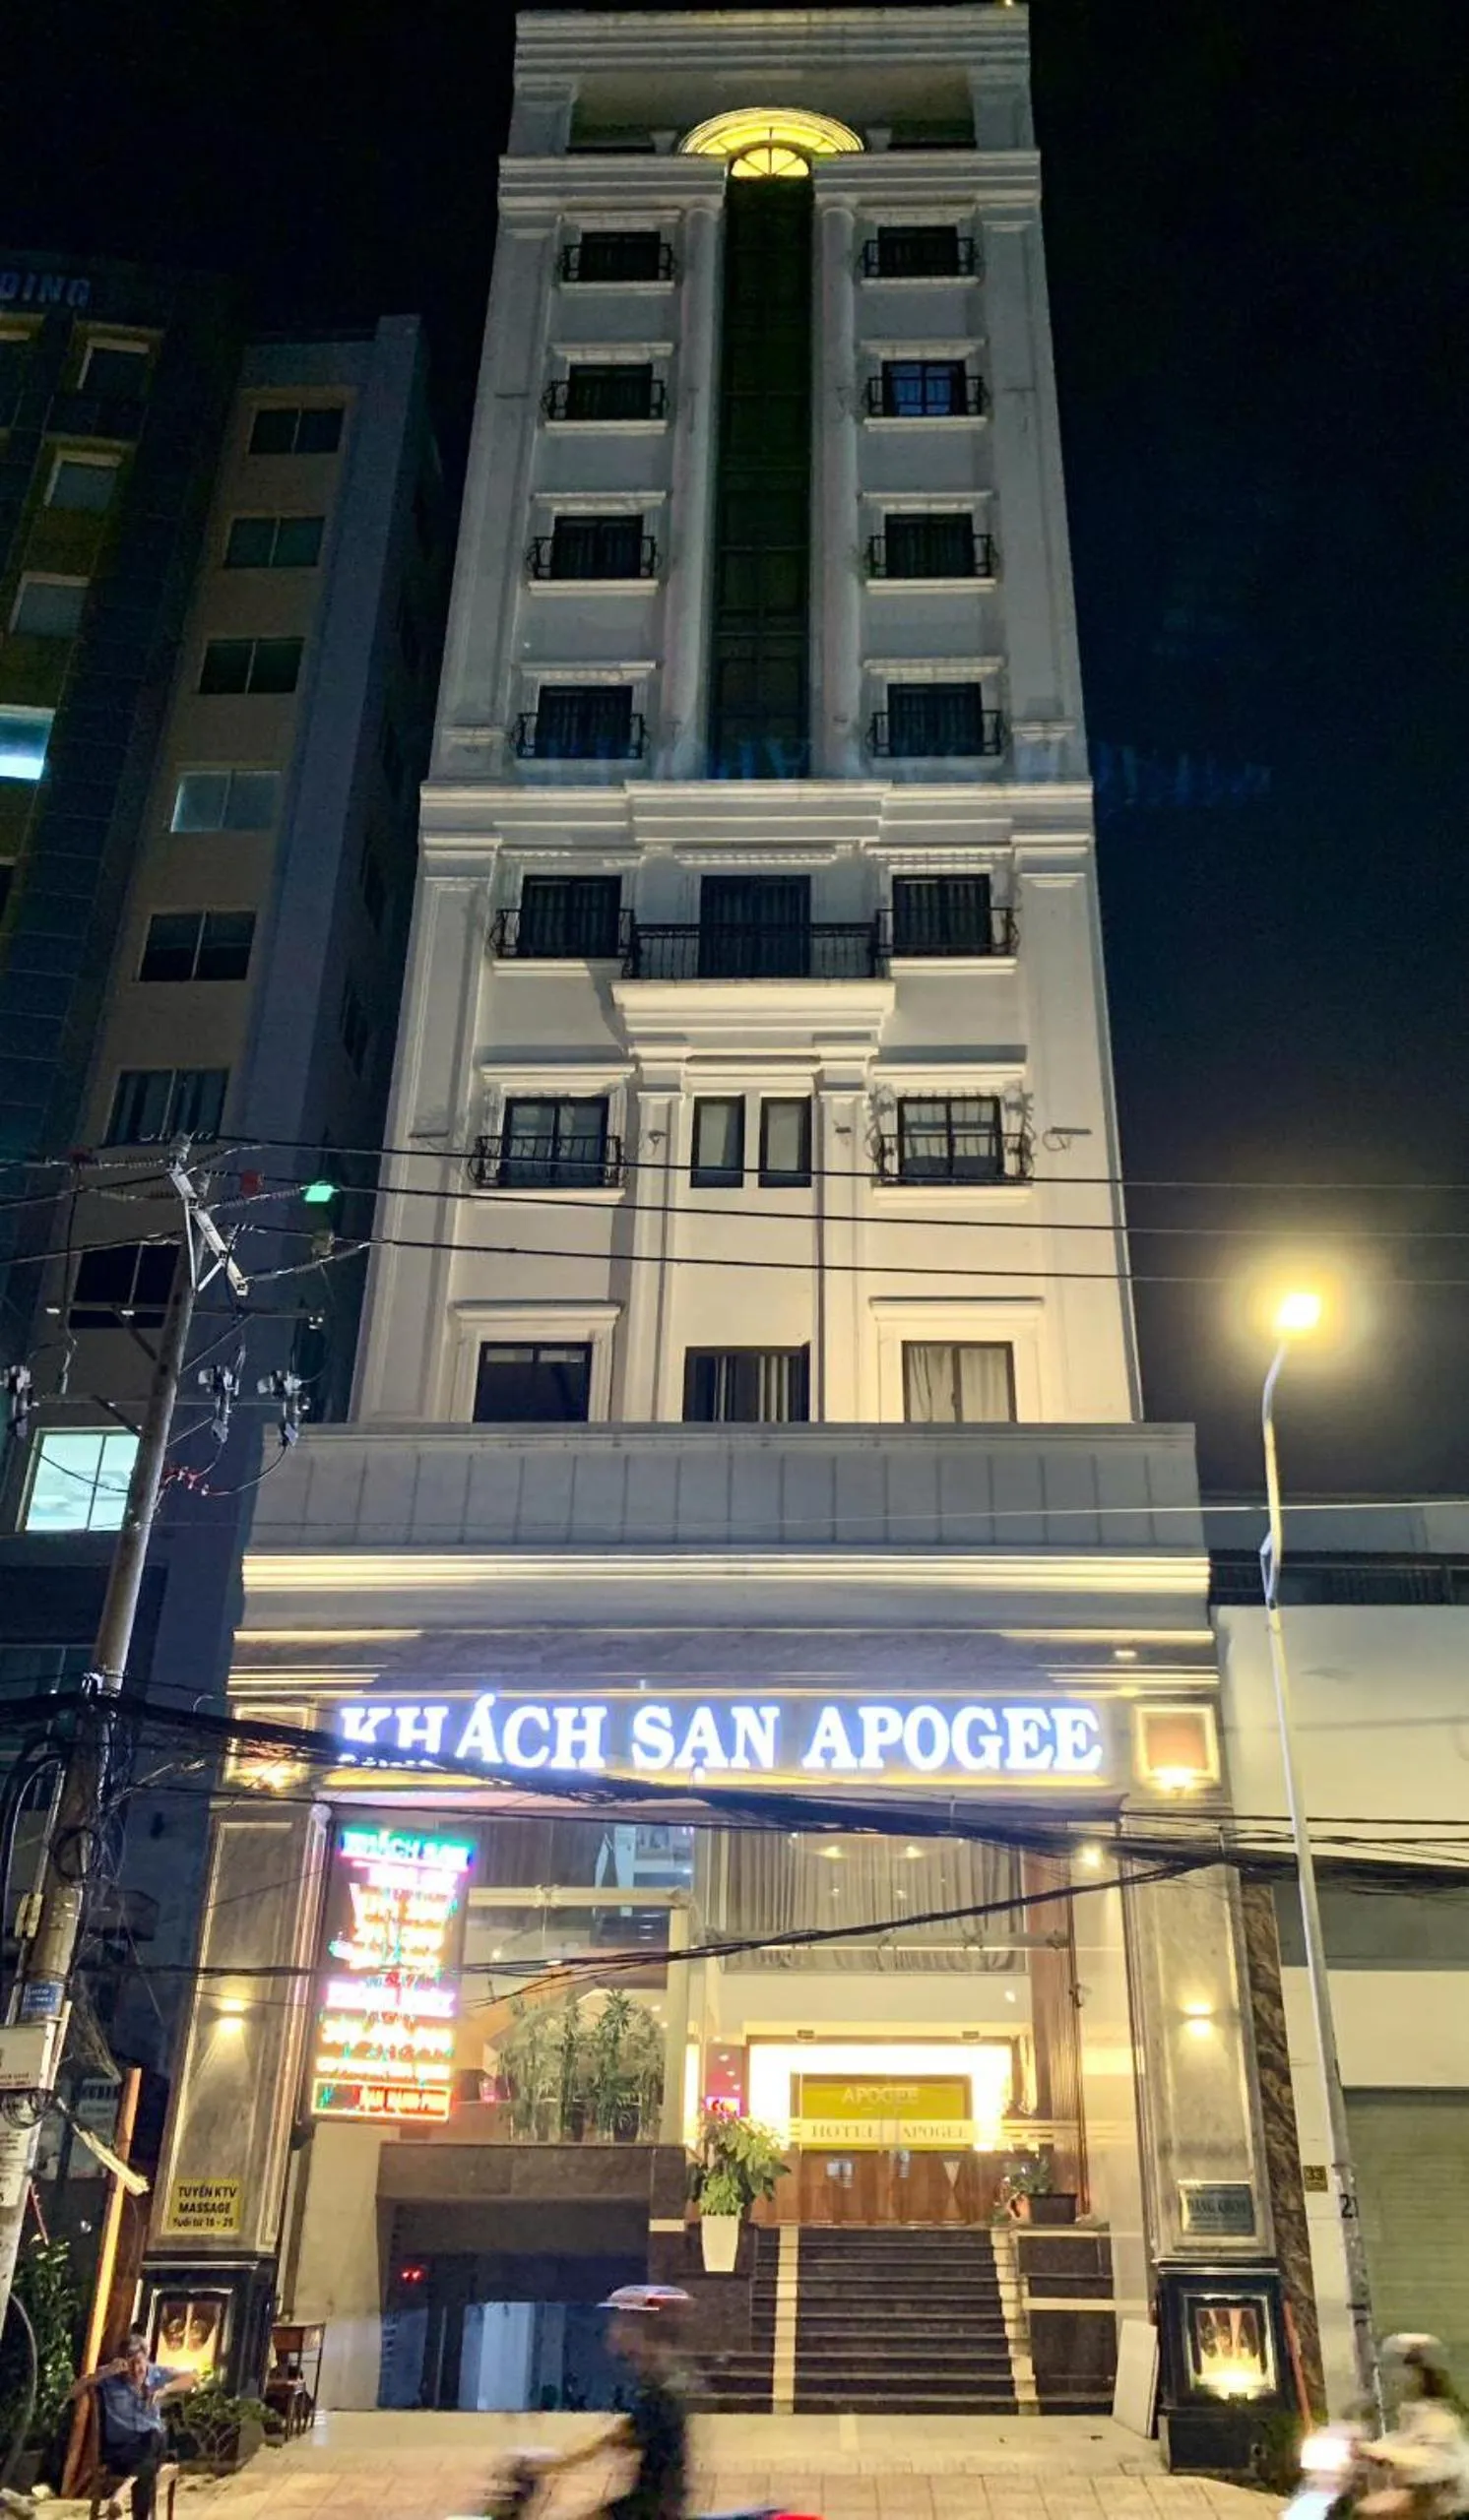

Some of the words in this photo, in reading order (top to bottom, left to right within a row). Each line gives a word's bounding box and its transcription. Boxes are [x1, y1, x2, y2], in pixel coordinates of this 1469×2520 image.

[339, 1692, 607, 1770] KHÁCH
[802, 1705, 1103, 1772] APOGEE
[810, 2123, 880, 2138] HOTEL
[215, 2186, 237, 2198] KTV
[178, 2202, 230, 2214] MASSAGE
